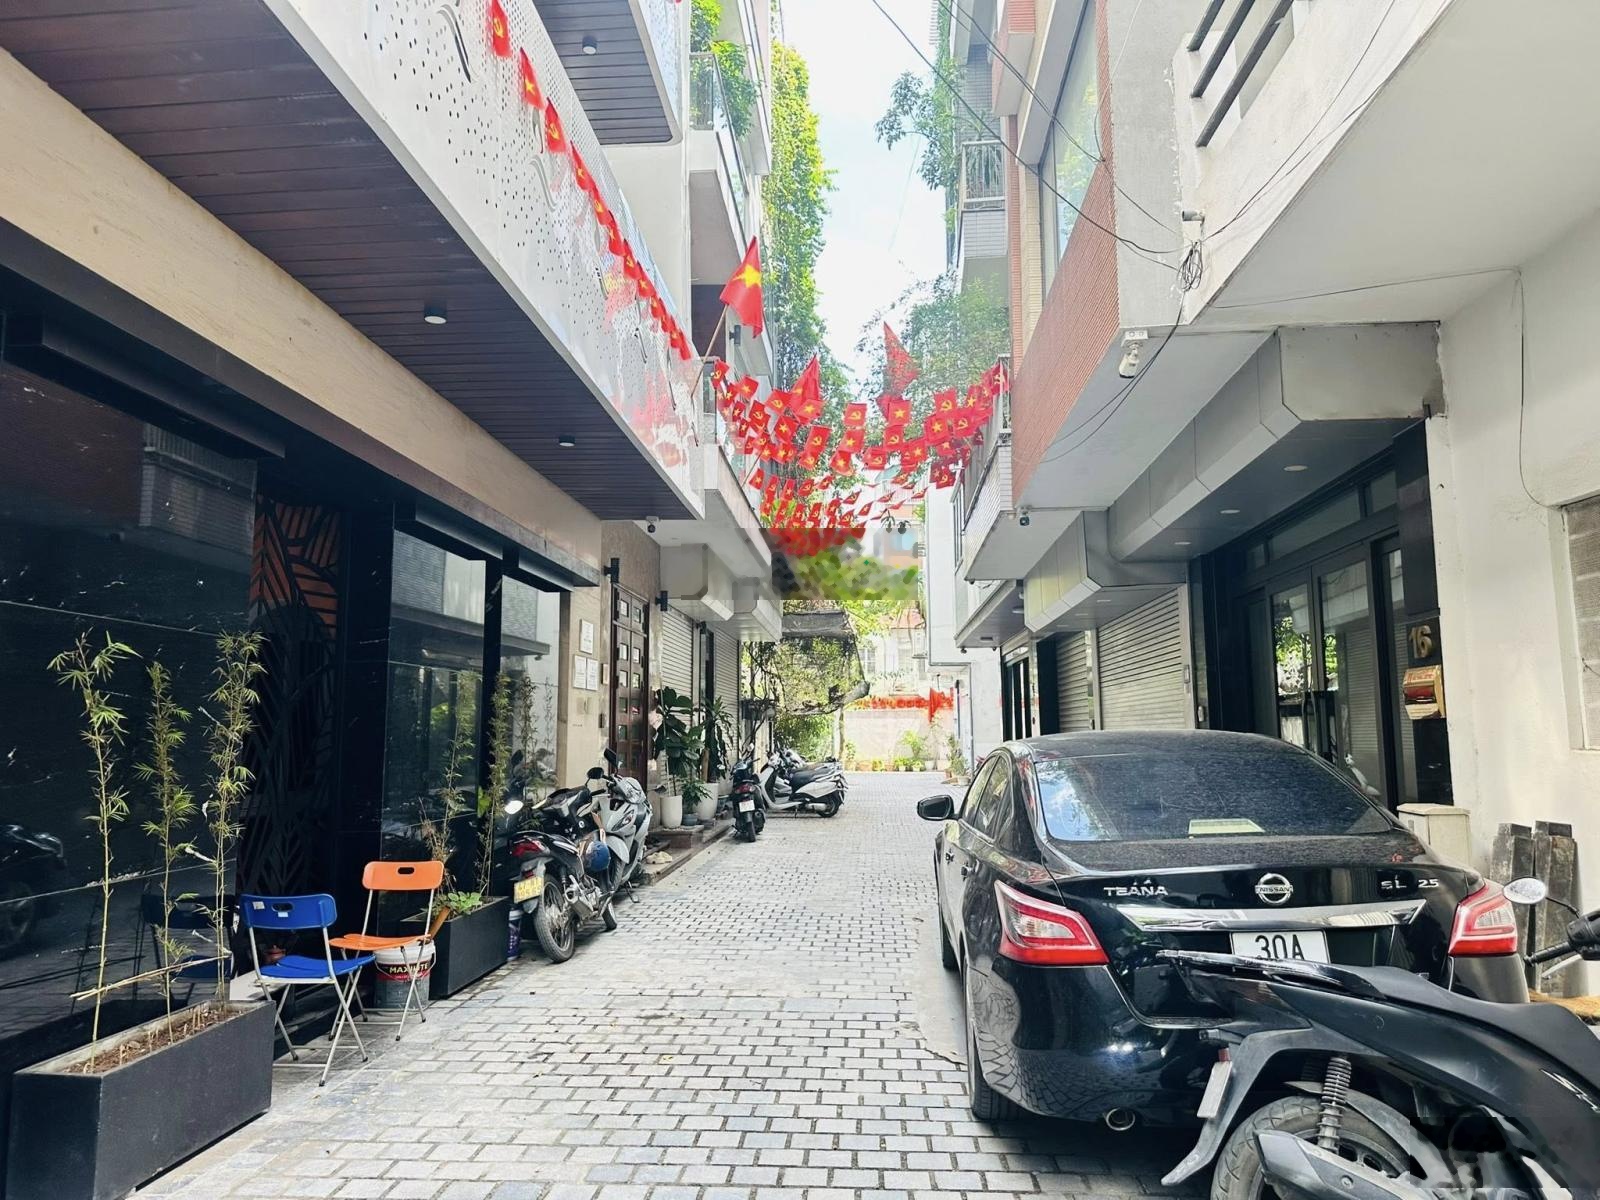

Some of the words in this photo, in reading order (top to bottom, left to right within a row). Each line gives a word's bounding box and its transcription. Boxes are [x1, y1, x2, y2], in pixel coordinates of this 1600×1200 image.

[1409, 625, 1432, 658] 16
[1381, 879, 1407, 889] SL
[1103, 886, 1169, 897] TEANA
[1255, 934, 1305, 960] 30A
[389, 962, 428, 974] MAXILTE
